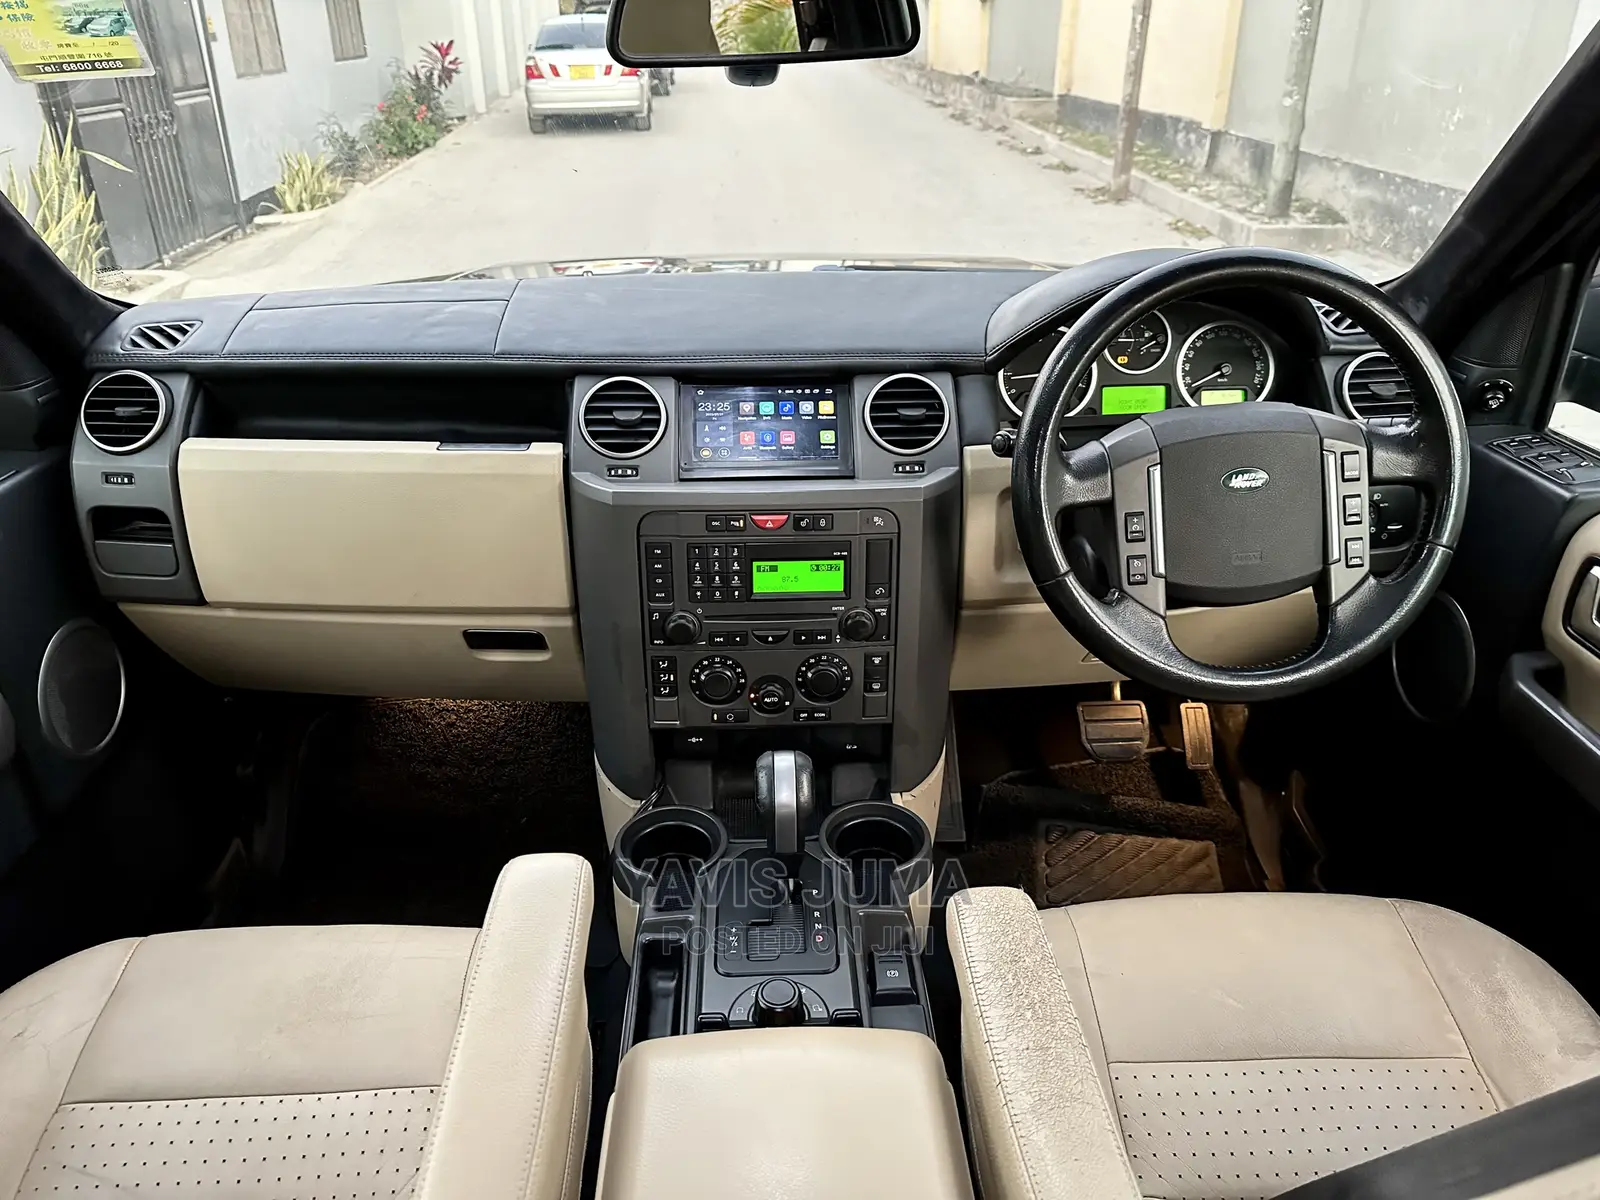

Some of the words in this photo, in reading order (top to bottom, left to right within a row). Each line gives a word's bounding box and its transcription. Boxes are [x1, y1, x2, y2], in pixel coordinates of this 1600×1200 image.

[36, 65, 60, 73] Tel:
[62, 62, 92, 72] 6800
[94, 60, 124, 69] 6668
[1195, 340, 1203, 348] 80
[1188, 350, 1195, 358] 60
[1185, 363, 1190, 371] 40
[698, 402, 730, 412] 23:25
[1233, 480, 1262, 488] ROVER
